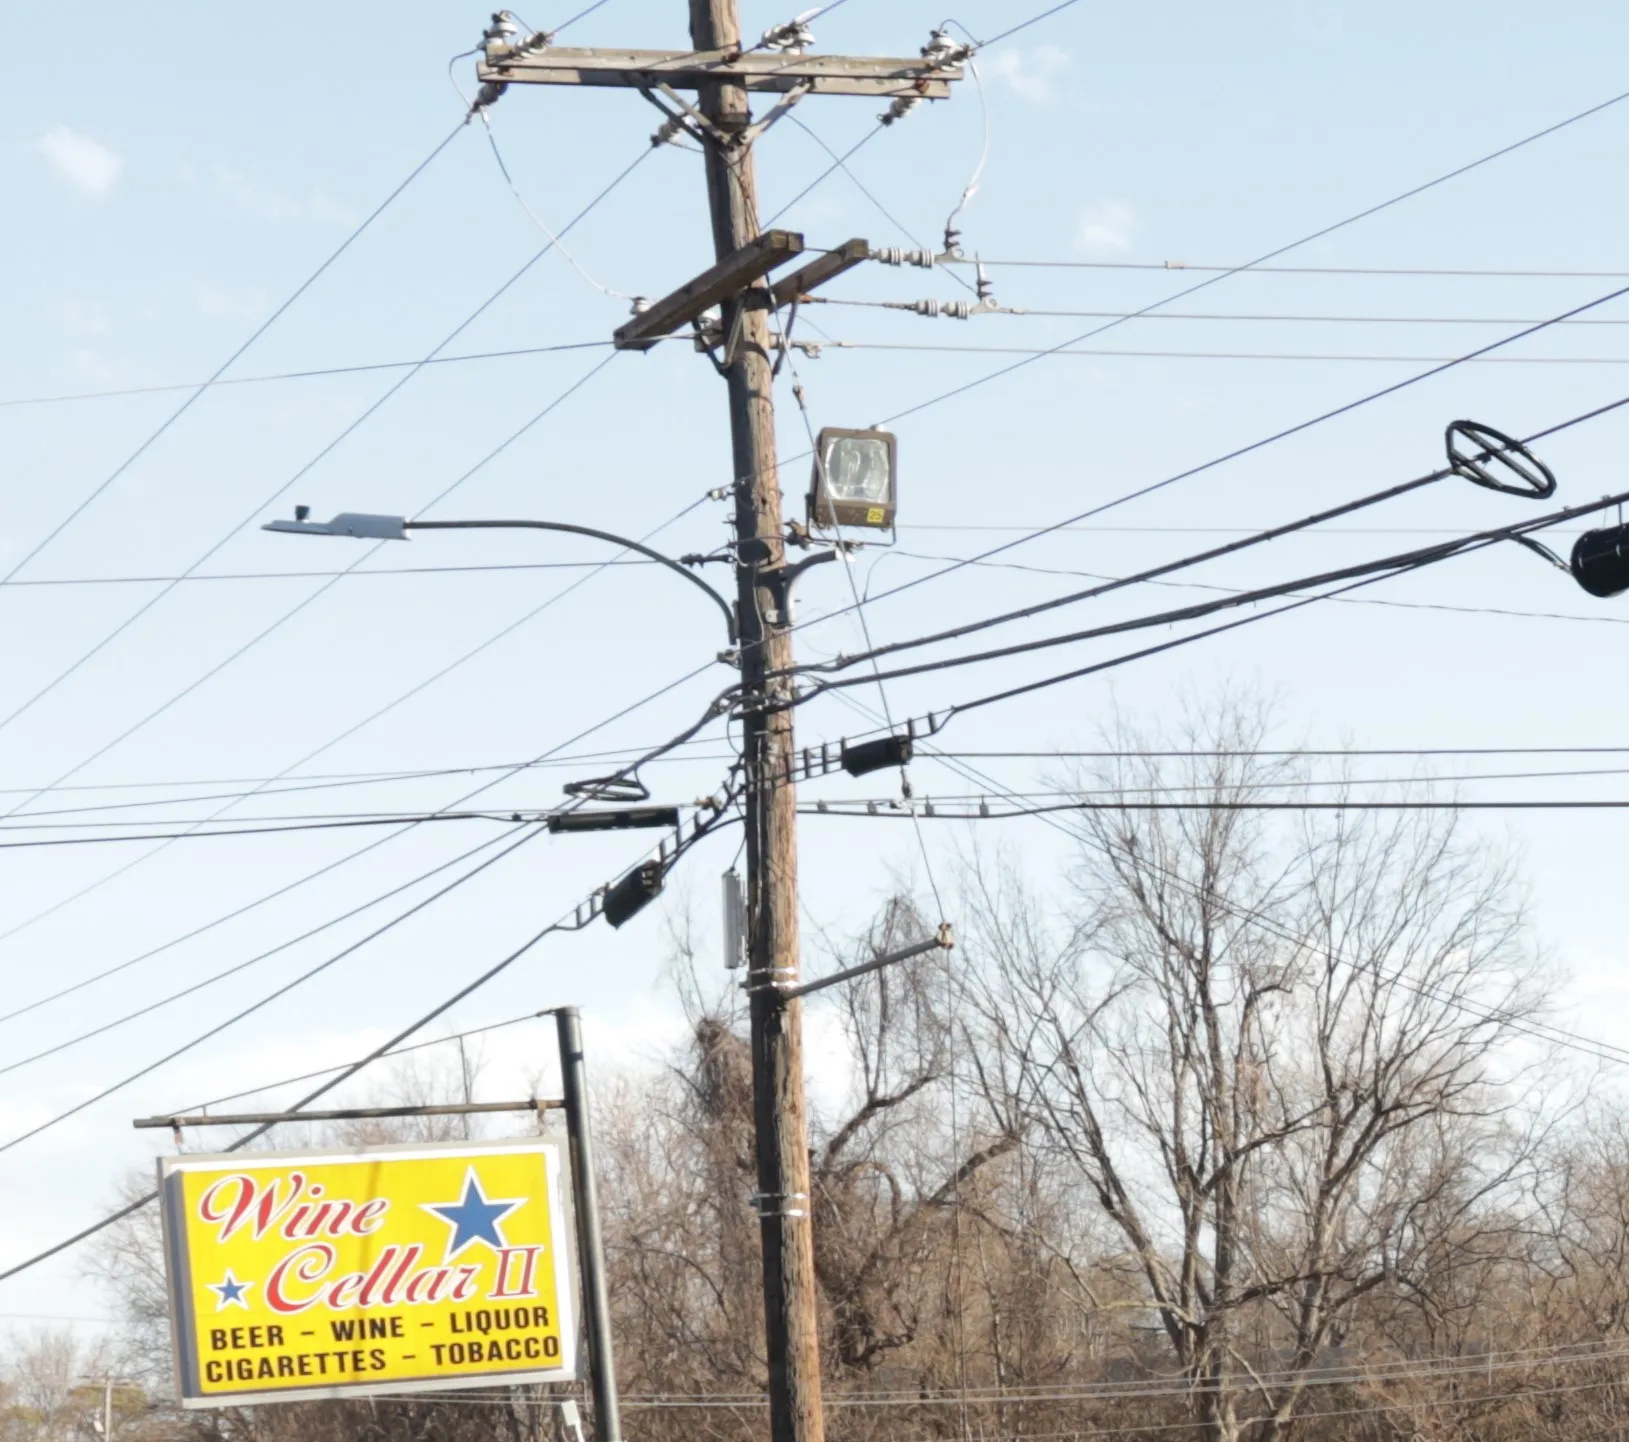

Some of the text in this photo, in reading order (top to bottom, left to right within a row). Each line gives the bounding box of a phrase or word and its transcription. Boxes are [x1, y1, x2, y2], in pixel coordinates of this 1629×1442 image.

[200, 1173, 388, 1242] Wine
[265, 1243, 543, 1313] Cellar II
[210, 1324, 285, 1351] BEER
[330, 1315, 404, 1343] WINE
[449, 1305, 550, 1335] LIQUOR
[205, 1347, 387, 1383] CIGARETTES
[434, 1335, 560, 1366] TOBACCO
